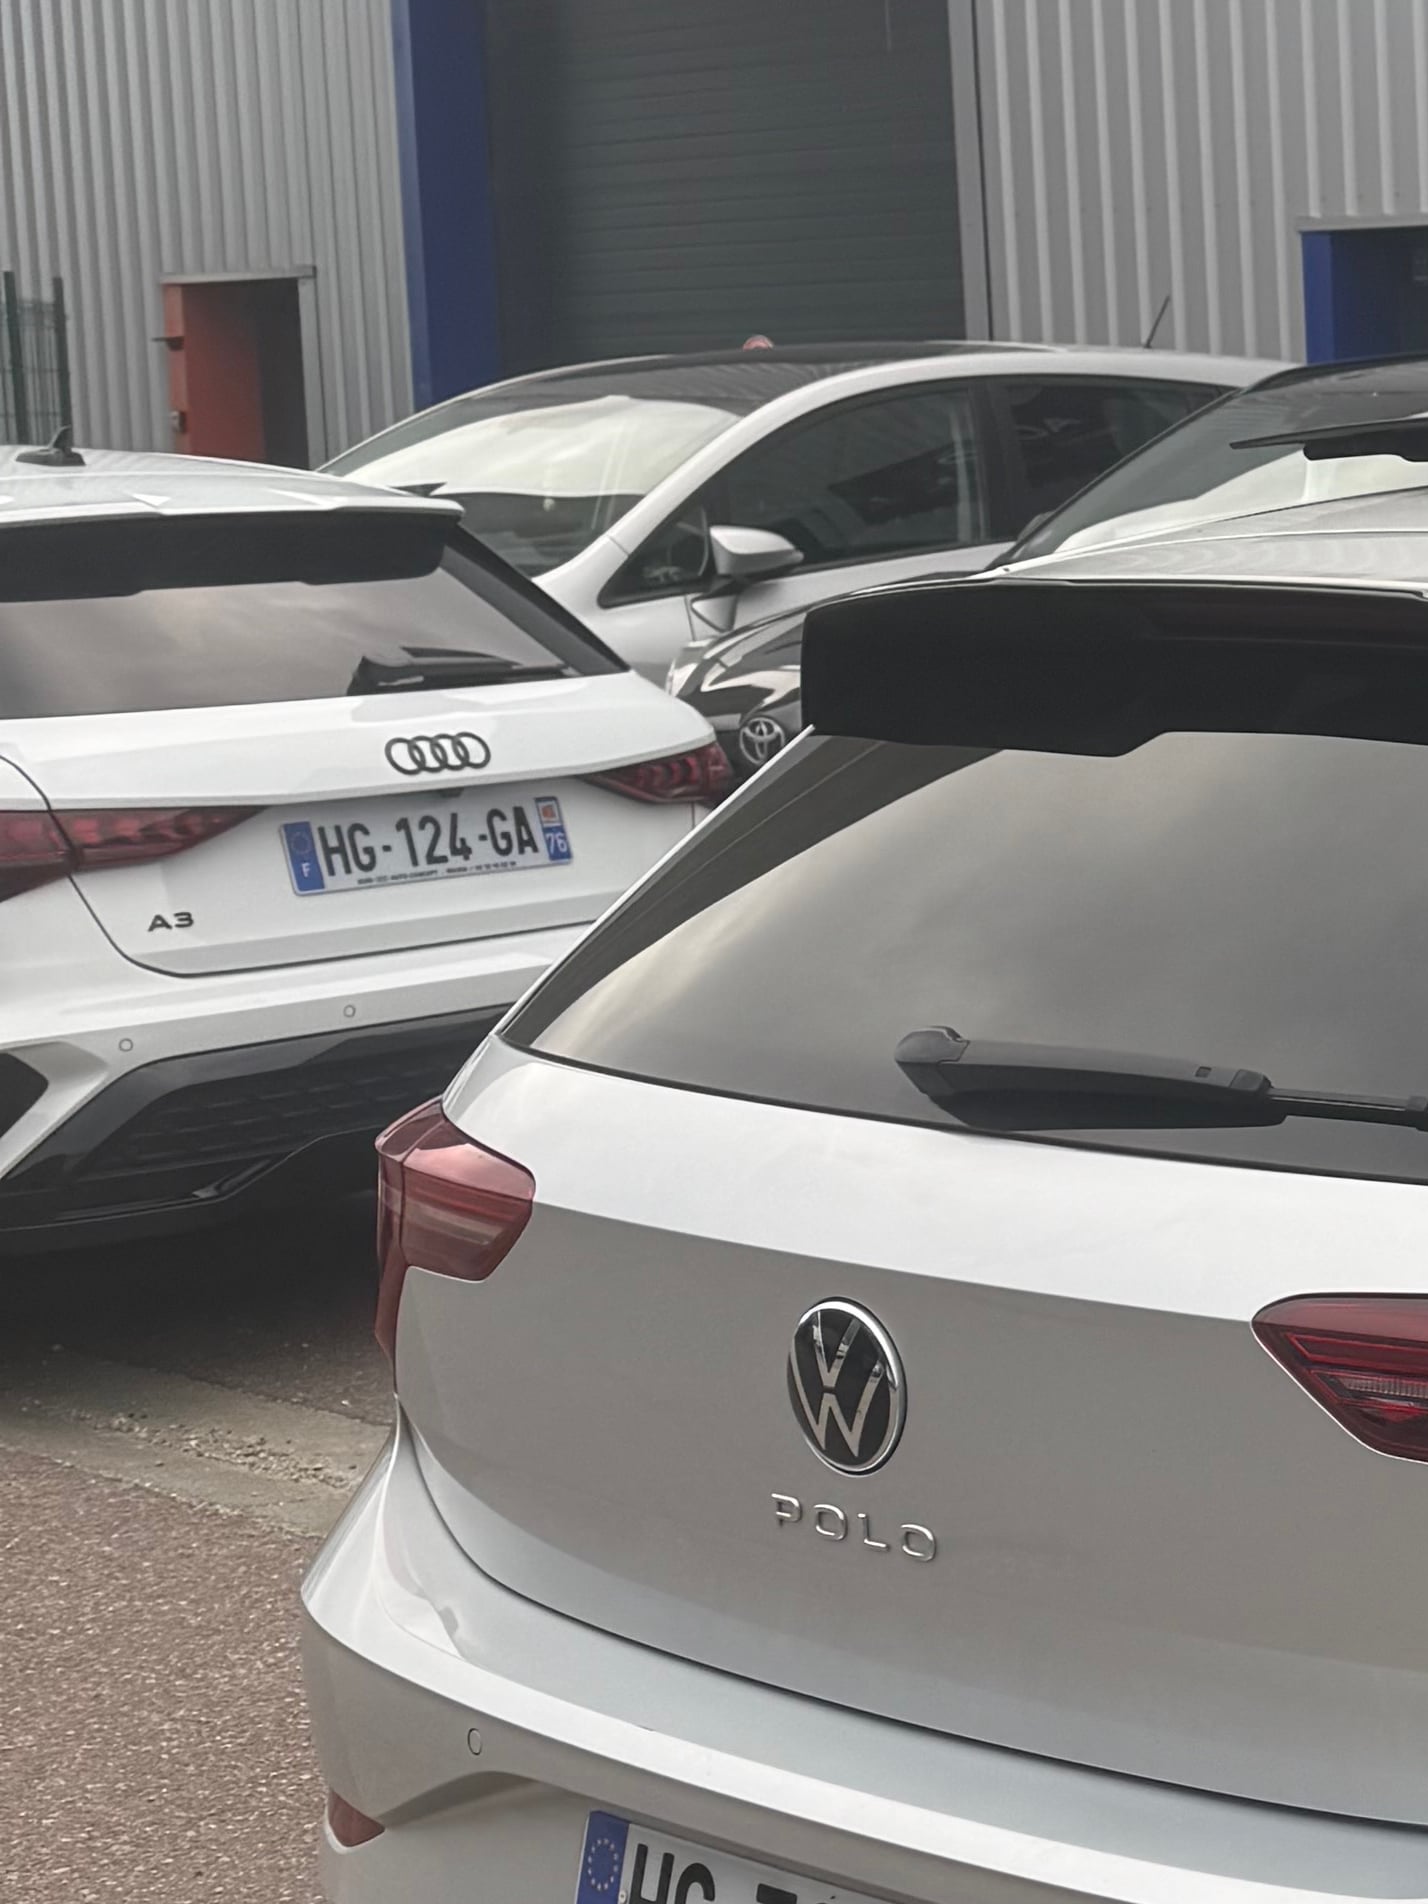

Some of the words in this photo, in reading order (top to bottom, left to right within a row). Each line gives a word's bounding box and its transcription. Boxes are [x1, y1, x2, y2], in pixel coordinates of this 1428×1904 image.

[302, 862, 310, 877] F
[317, 806, 539, 876] HG-124-GA
[546, 832, 568, 854] 76
[147, 911, 194, 932] A3
[771, 1493, 937, 1562] POLO
